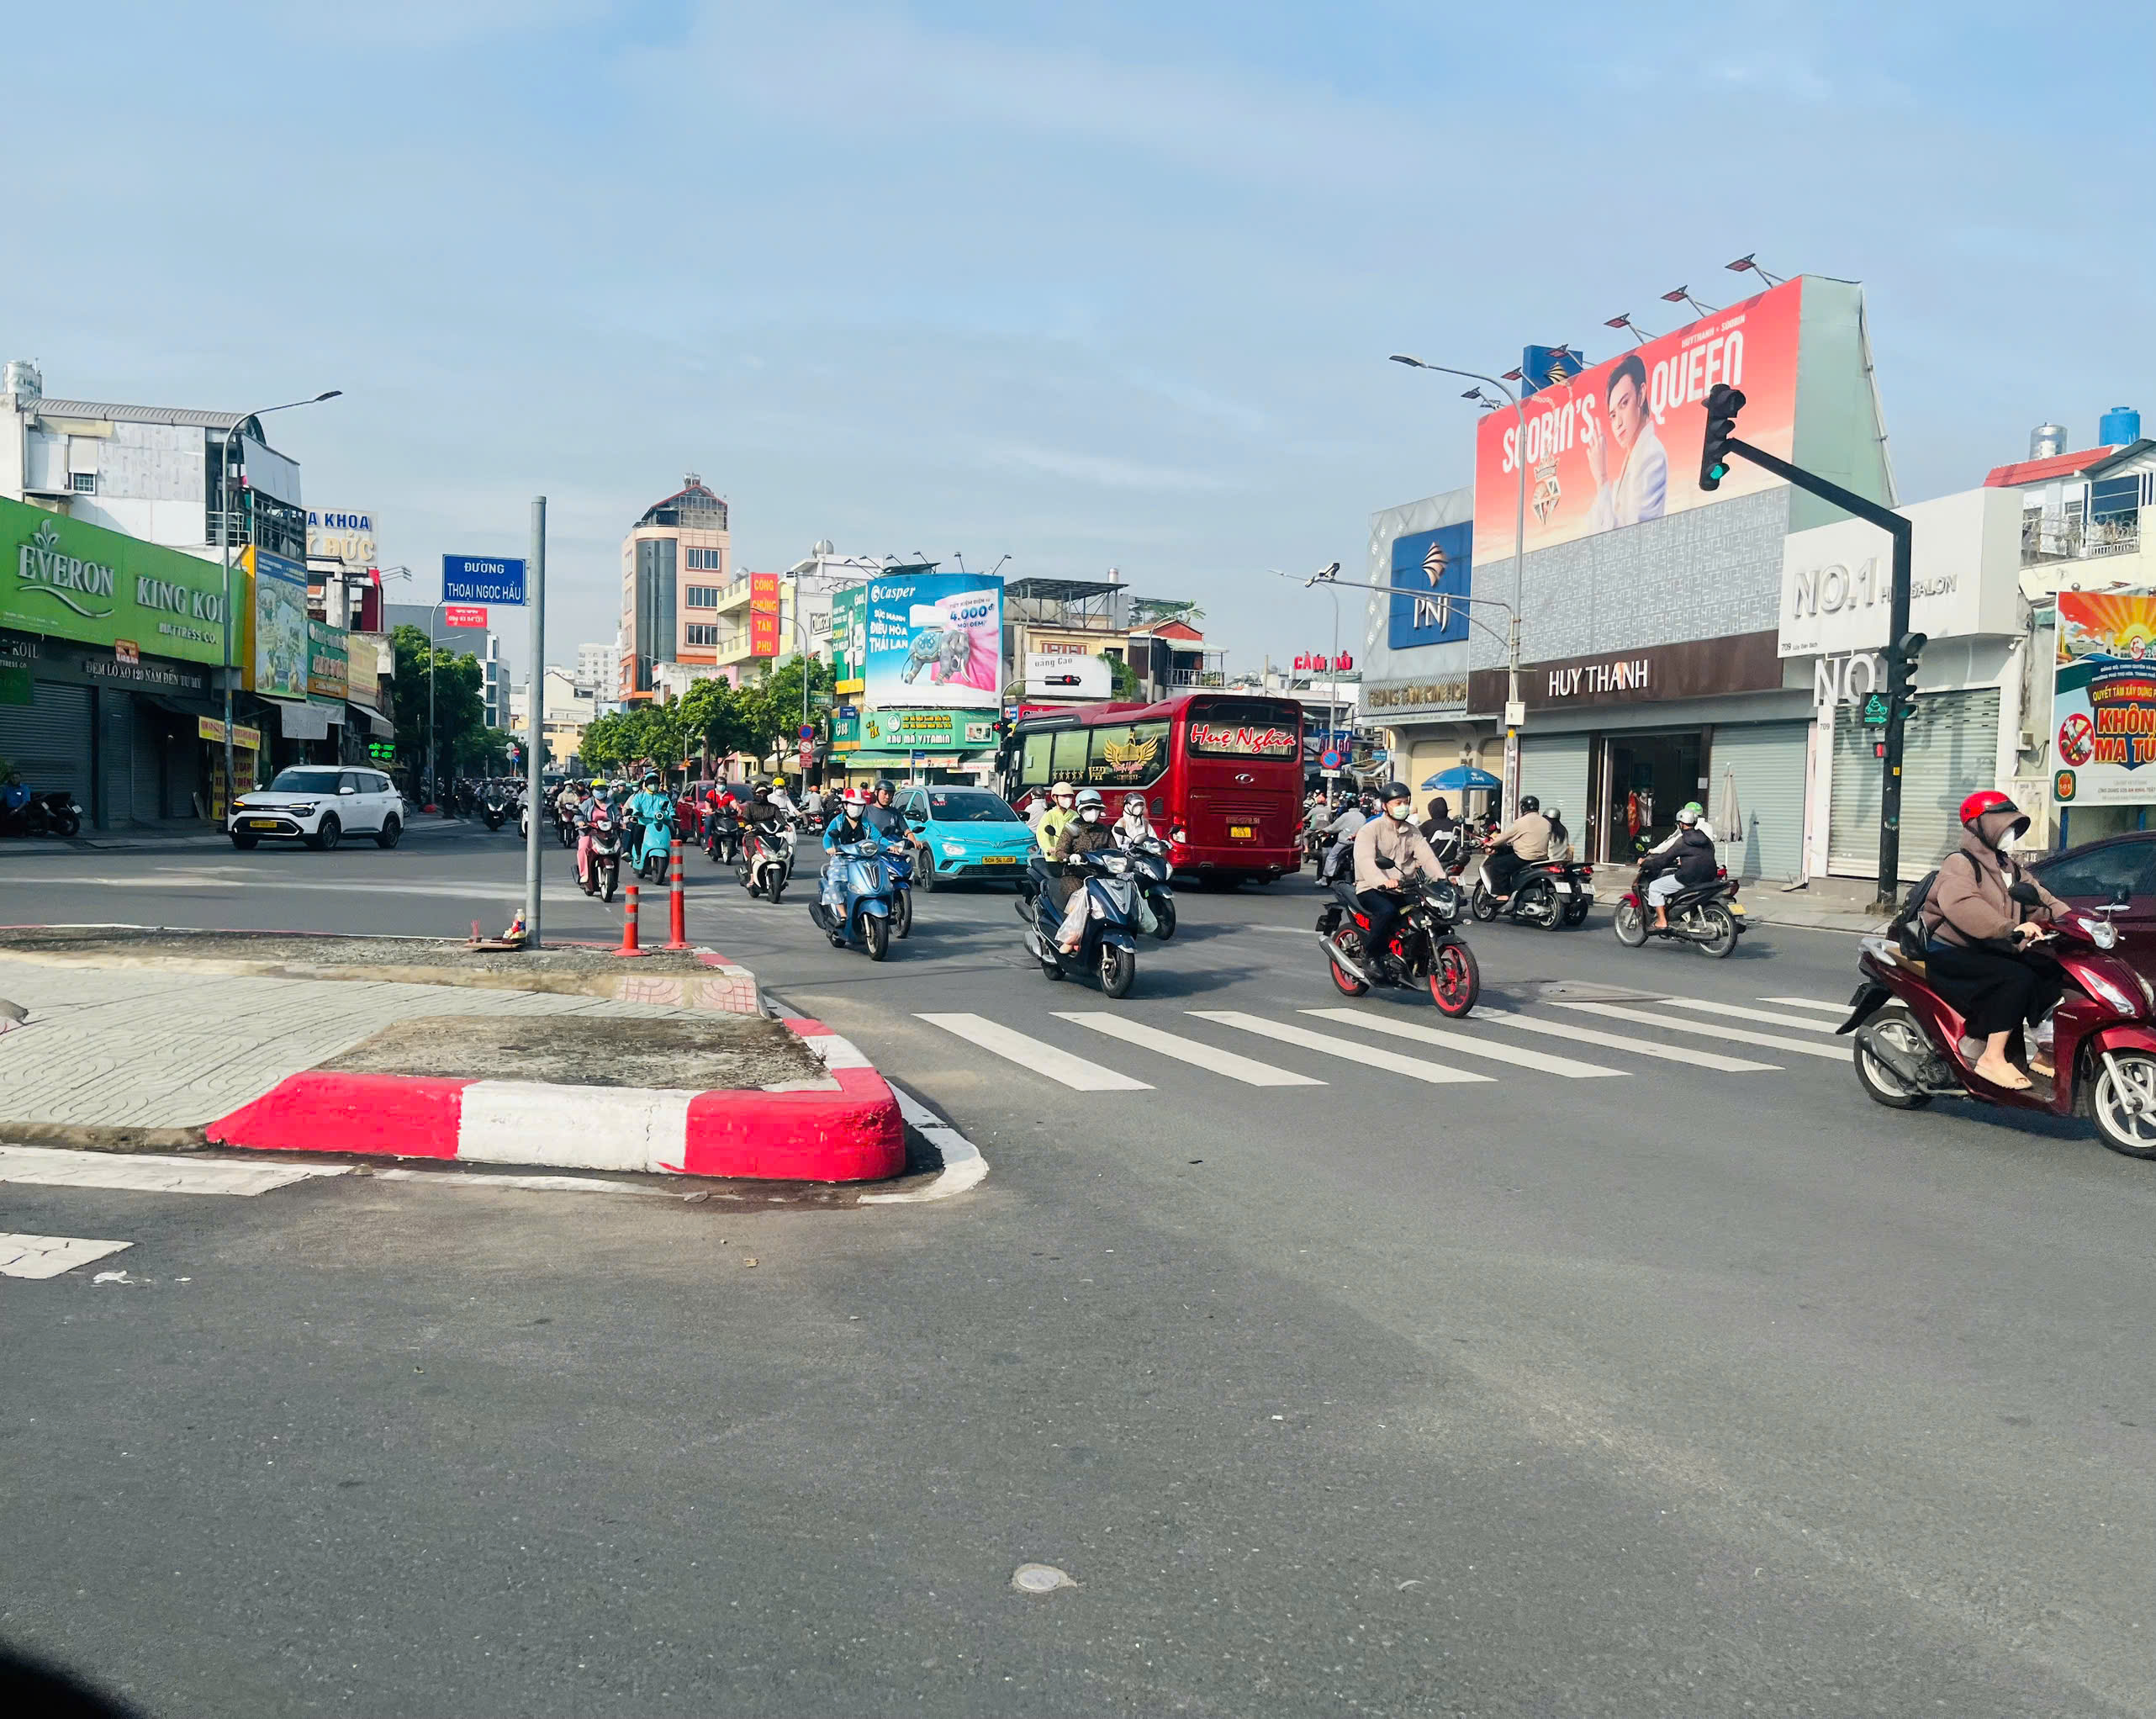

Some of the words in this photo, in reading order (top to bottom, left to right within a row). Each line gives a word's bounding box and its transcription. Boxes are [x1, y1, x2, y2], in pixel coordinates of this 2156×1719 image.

[1651, 331, 1744, 423] QUEEN
[325, 512, 370, 530] KHOA
[323, 530, 375, 561] ĐỨC
[18, 544, 114, 598] EVERON
[464, 559, 505, 574] ĐƯỜNG
[136, 575, 187, 614] KING
[193, 590, 234, 626] KOI
[447, 583, 474, 601] THOẠI
[476, 584, 501, 602] NGỌC
[880, 586, 916, 601] Casper
[1794, 558, 1878, 620] NO.1
[1910, 574, 1958, 600] SALON
[1414, 592, 1449, 632] PNJ
[158, 622, 201, 643] MATTRESS
[890, 639, 908, 649] LAN
[1548, 667, 1583, 697] HUY
[1585, 659, 1648, 693] THANH
[2092, 685, 2112, 701] QUYẾT
[2097, 702, 2156, 735] KHÔN
[886, 734, 902, 744] RAU
[904, 732, 917, 744] MÁ
[918, 733, 951, 744] VITAMIN
[1191, 723, 1233, 748] Huệ
[1235, 727, 1297, 754] Nghĩa
[2094, 738, 2127, 764] MA
